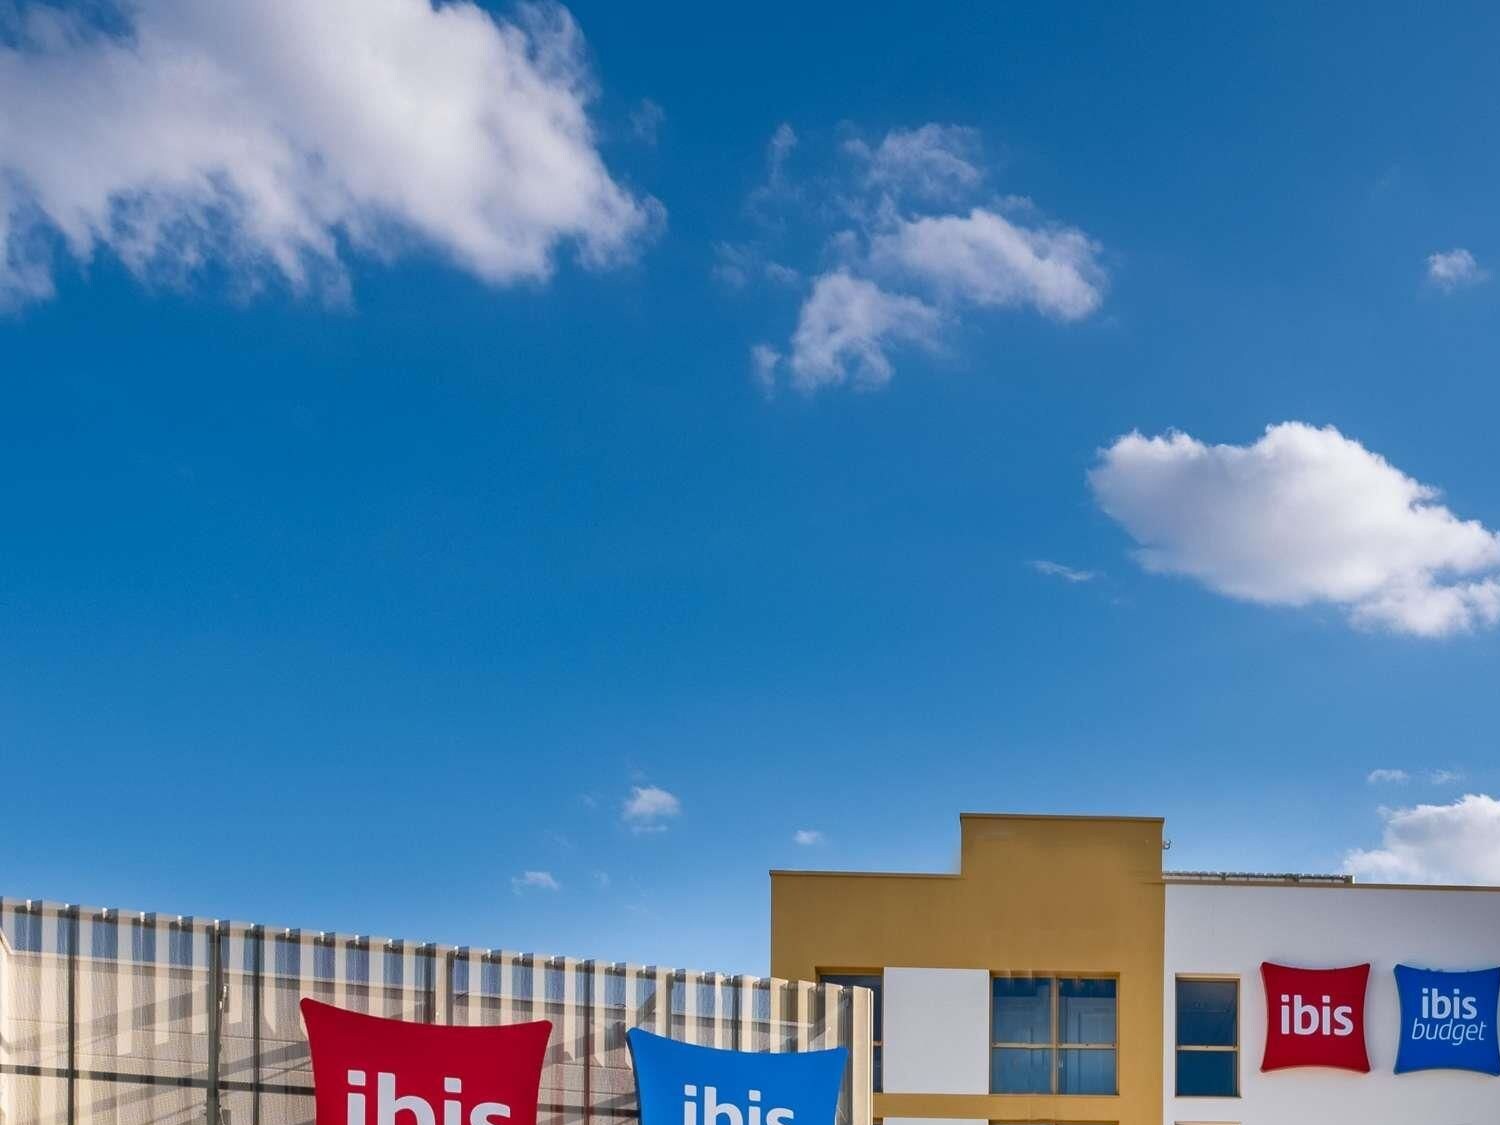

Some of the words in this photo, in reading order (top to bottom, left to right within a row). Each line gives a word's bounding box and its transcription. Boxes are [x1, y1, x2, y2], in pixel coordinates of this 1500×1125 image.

[1280, 994, 1354, 1036] ibis
[1422, 988, 1478, 1020] ibis
[1411, 1018, 1487, 1045] budget
